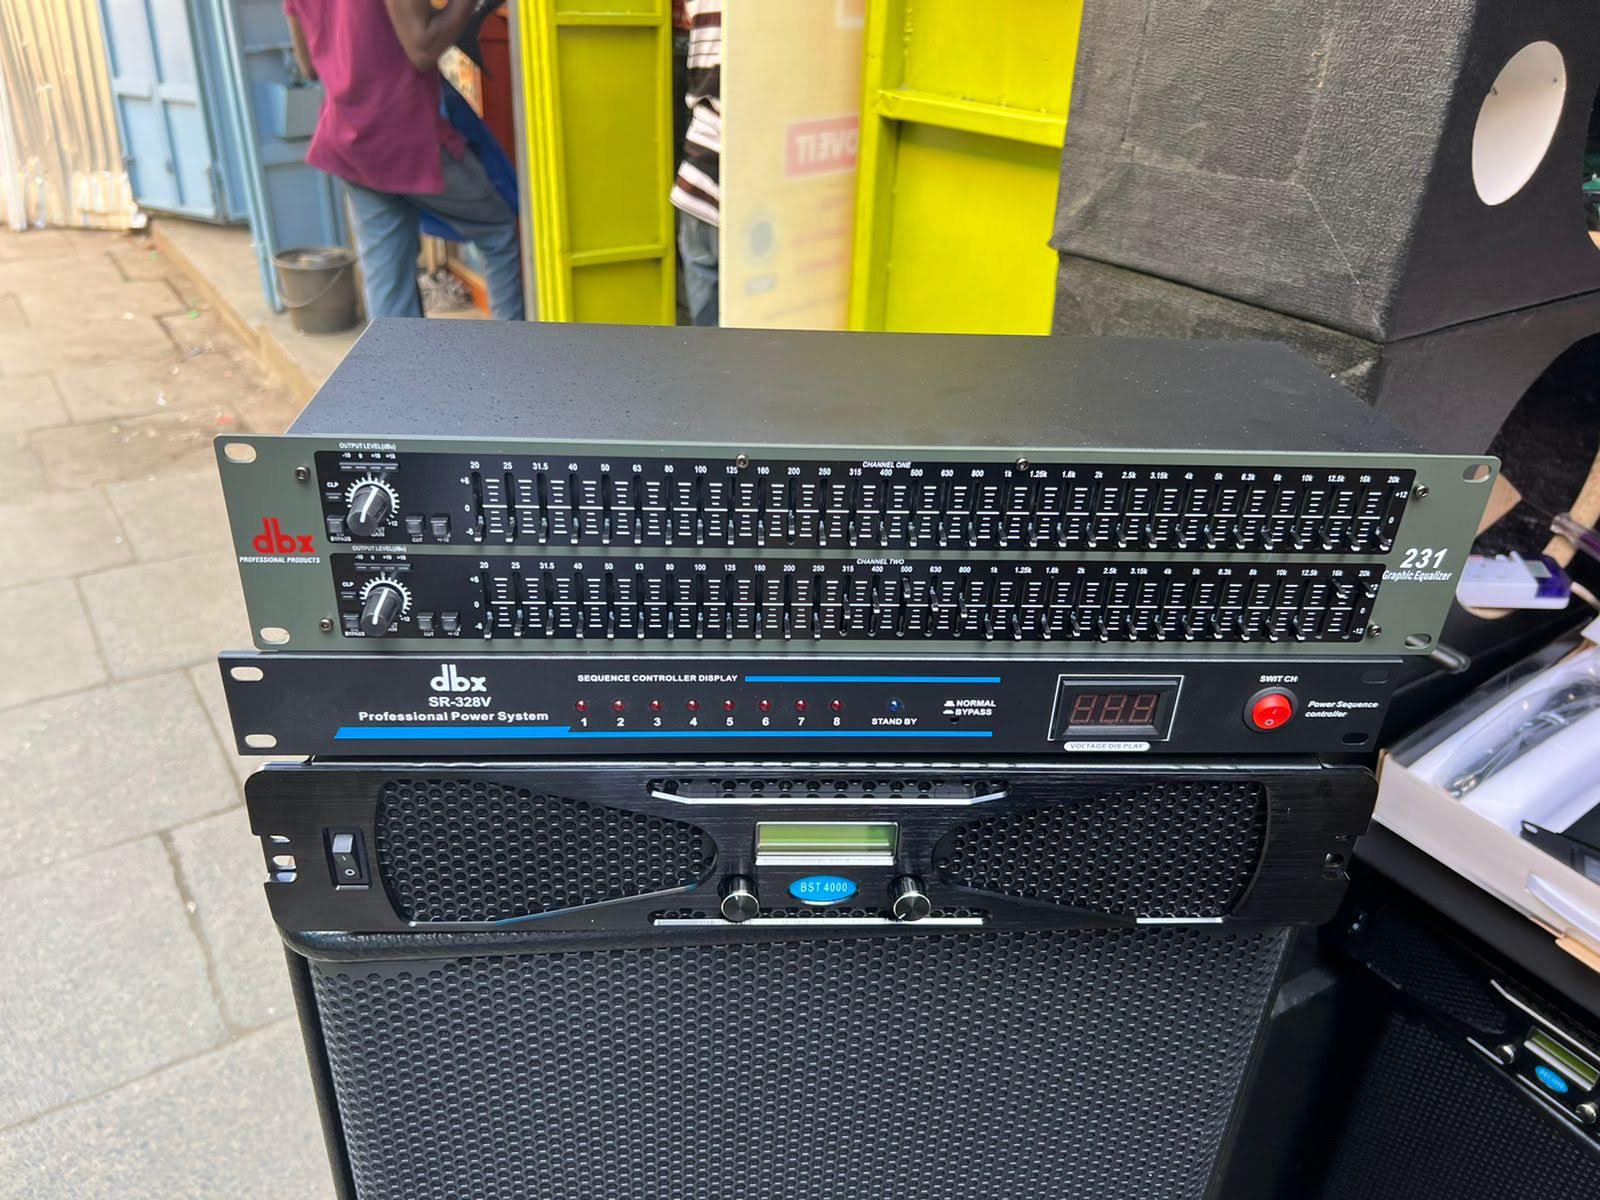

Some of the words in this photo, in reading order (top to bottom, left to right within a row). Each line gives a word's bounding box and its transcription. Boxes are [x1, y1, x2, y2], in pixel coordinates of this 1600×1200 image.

[469, 460, 481, 470] 20
[502, 461, 513, 470] 25
[532, 461, 549, 471] 31.5
[567, 462, 578, 472] 40
[600, 463, 611, 472] 50
[694, 464, 708, 474] 100
[725, 466, 738, 475] 125
[787, 466, 801, 476] 200
[818, 467, 832, 476] 250
[848, 468, 862, 476] 315
[910, 469, 923, 477] 500
[862, 461, 895, 469] CHANNEL
[1395, 491, 1408, 499] +12
[464, 504, 471, 512] 0
[252, 517, 316, 555] dbx
[240, 556, 285, 564] PROFESSIONAL
[287, 556, 320, 564] PRODUCTS
[1400, 549, 1448, 569] 231
[479, 561, 490, 569] 20
[510, 561, 521, 570] 25
[538, 561, 556, 570] 31.5
[573, 562, 583, 570] 40
[604, 562, 614, 571] 50
[694, 563, 707, 572] 100
[724, 563, 737, 572] 125
[782, 564, 796, 572] 200
[812, 564, 826, 573] 250
[1382, 570, 1413, 582] Graphic
[1414, 570, 1452, 582] Equalizer
[430, 664, 487, 692] dbx
[577, 674, 630, 682] SEQUENCE
[632, 674, 697, 682] CONTROLLER
[428, 696, 492, 708] SR-328V
[955, 700, 996, 708] NORMAL
[1308, 700, 1338, 708] Power
[1336, 700, 1379, 709] Sequence
[358, 711, 449, 722] Professional
[451, 711, 495, 722] Power
[497, 711, 549, 723] System
[954, 708, 993, 716] BYPASS
[580, 717, 588, 727] 1
[616, 717, 625, 727] 2
[653, 717, 662, 727] 3
[689, 717, 698, 727] 4
[726, 717, 734, 727] 5
[762, 717, 769, 727] 6
[798, 717, 806, 727] 7
[833, 717, 841, 727] 8
[871, 718, 903, 726] STAND
[903, 718, 918, 726] BY
[800, 882, 821, 893] BST
[823, 882, 848, 893] 4000
